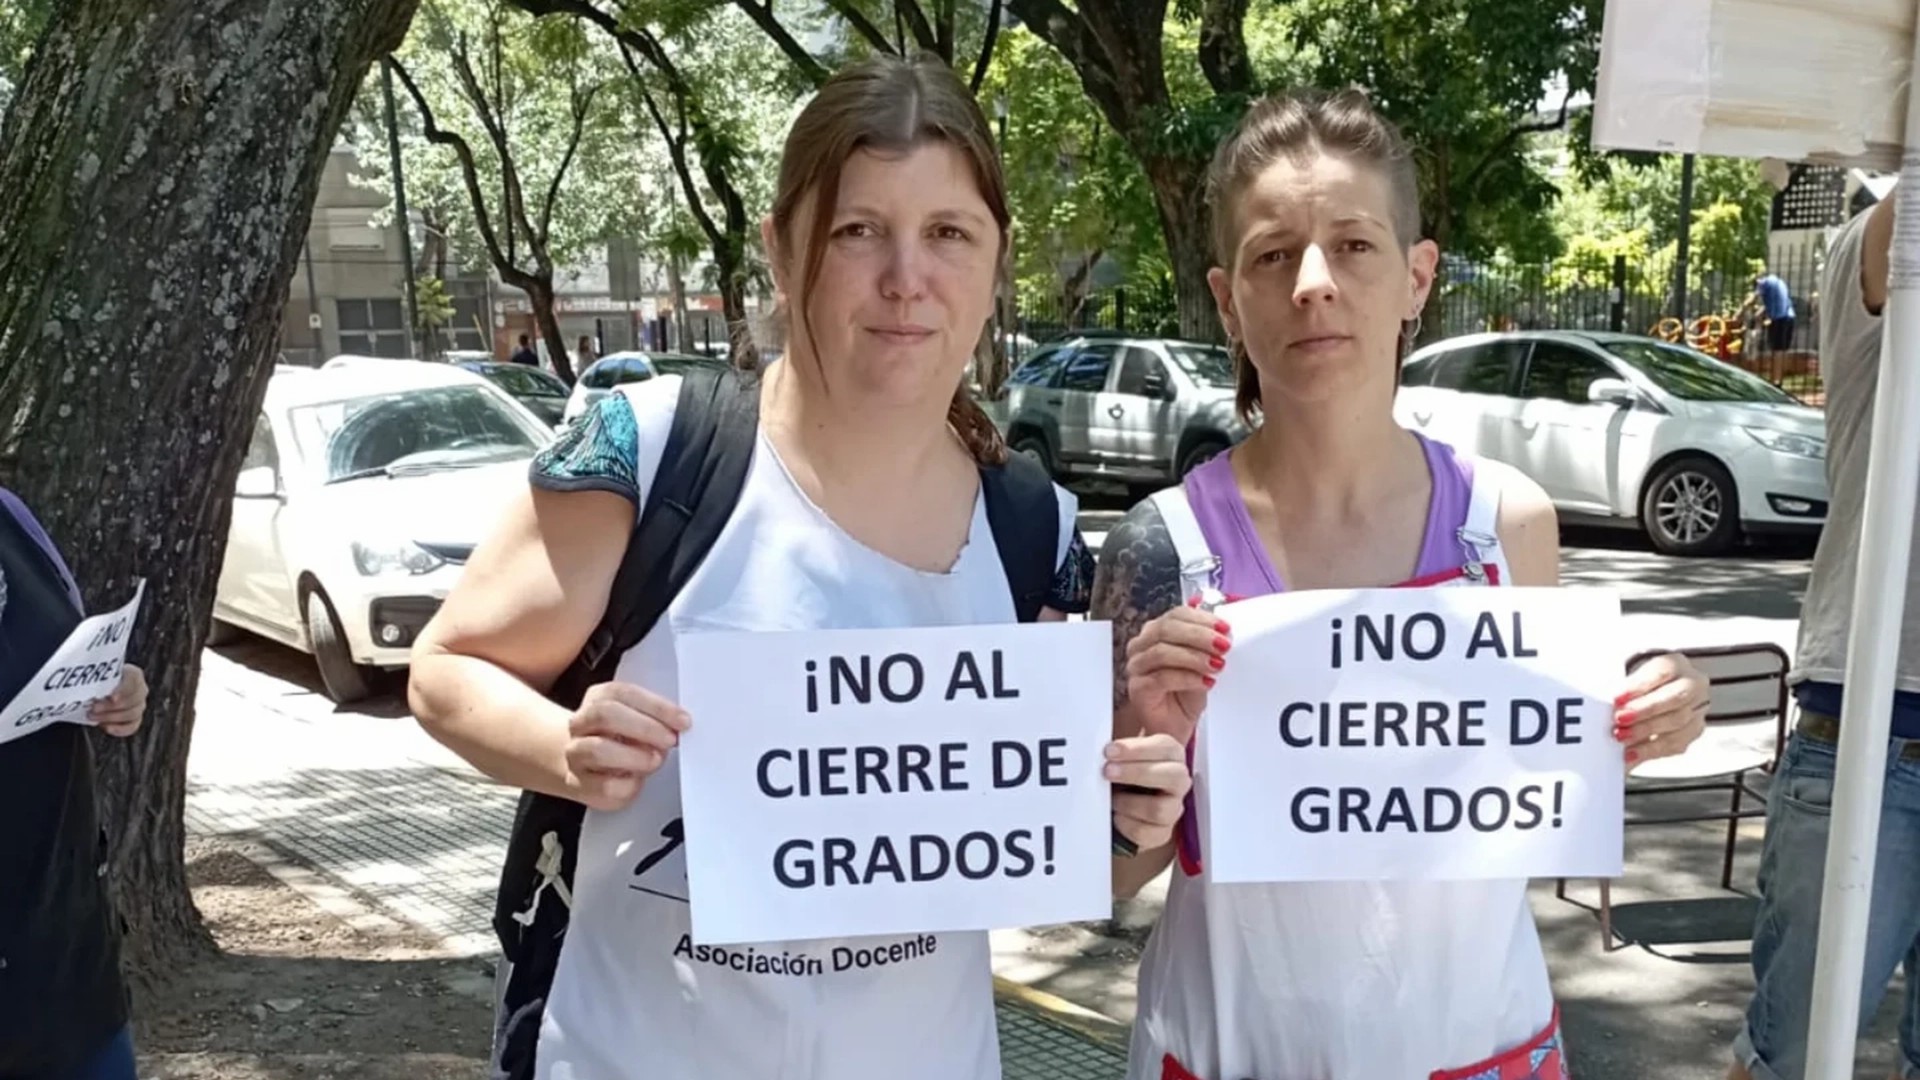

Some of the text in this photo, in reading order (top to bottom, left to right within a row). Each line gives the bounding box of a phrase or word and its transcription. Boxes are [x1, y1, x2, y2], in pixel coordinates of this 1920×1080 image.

[86, 616, 126, 651] ¡NO
[1331, 611, 1538, 669] ¡NO AL
[44, 658, 118, 691] CIERRE
[805, 649, 1020, 713] ¡NO AL
[1278, 697, 1584, 749] CIERRE DE
[756, 737, 1068, 799] CIERRE DE
[1290, 781, 1564, 834] GRADOS!
[772, 825, 1056, 889] GRADOS!
[672, 932, 937, 977] Asociación Docente
